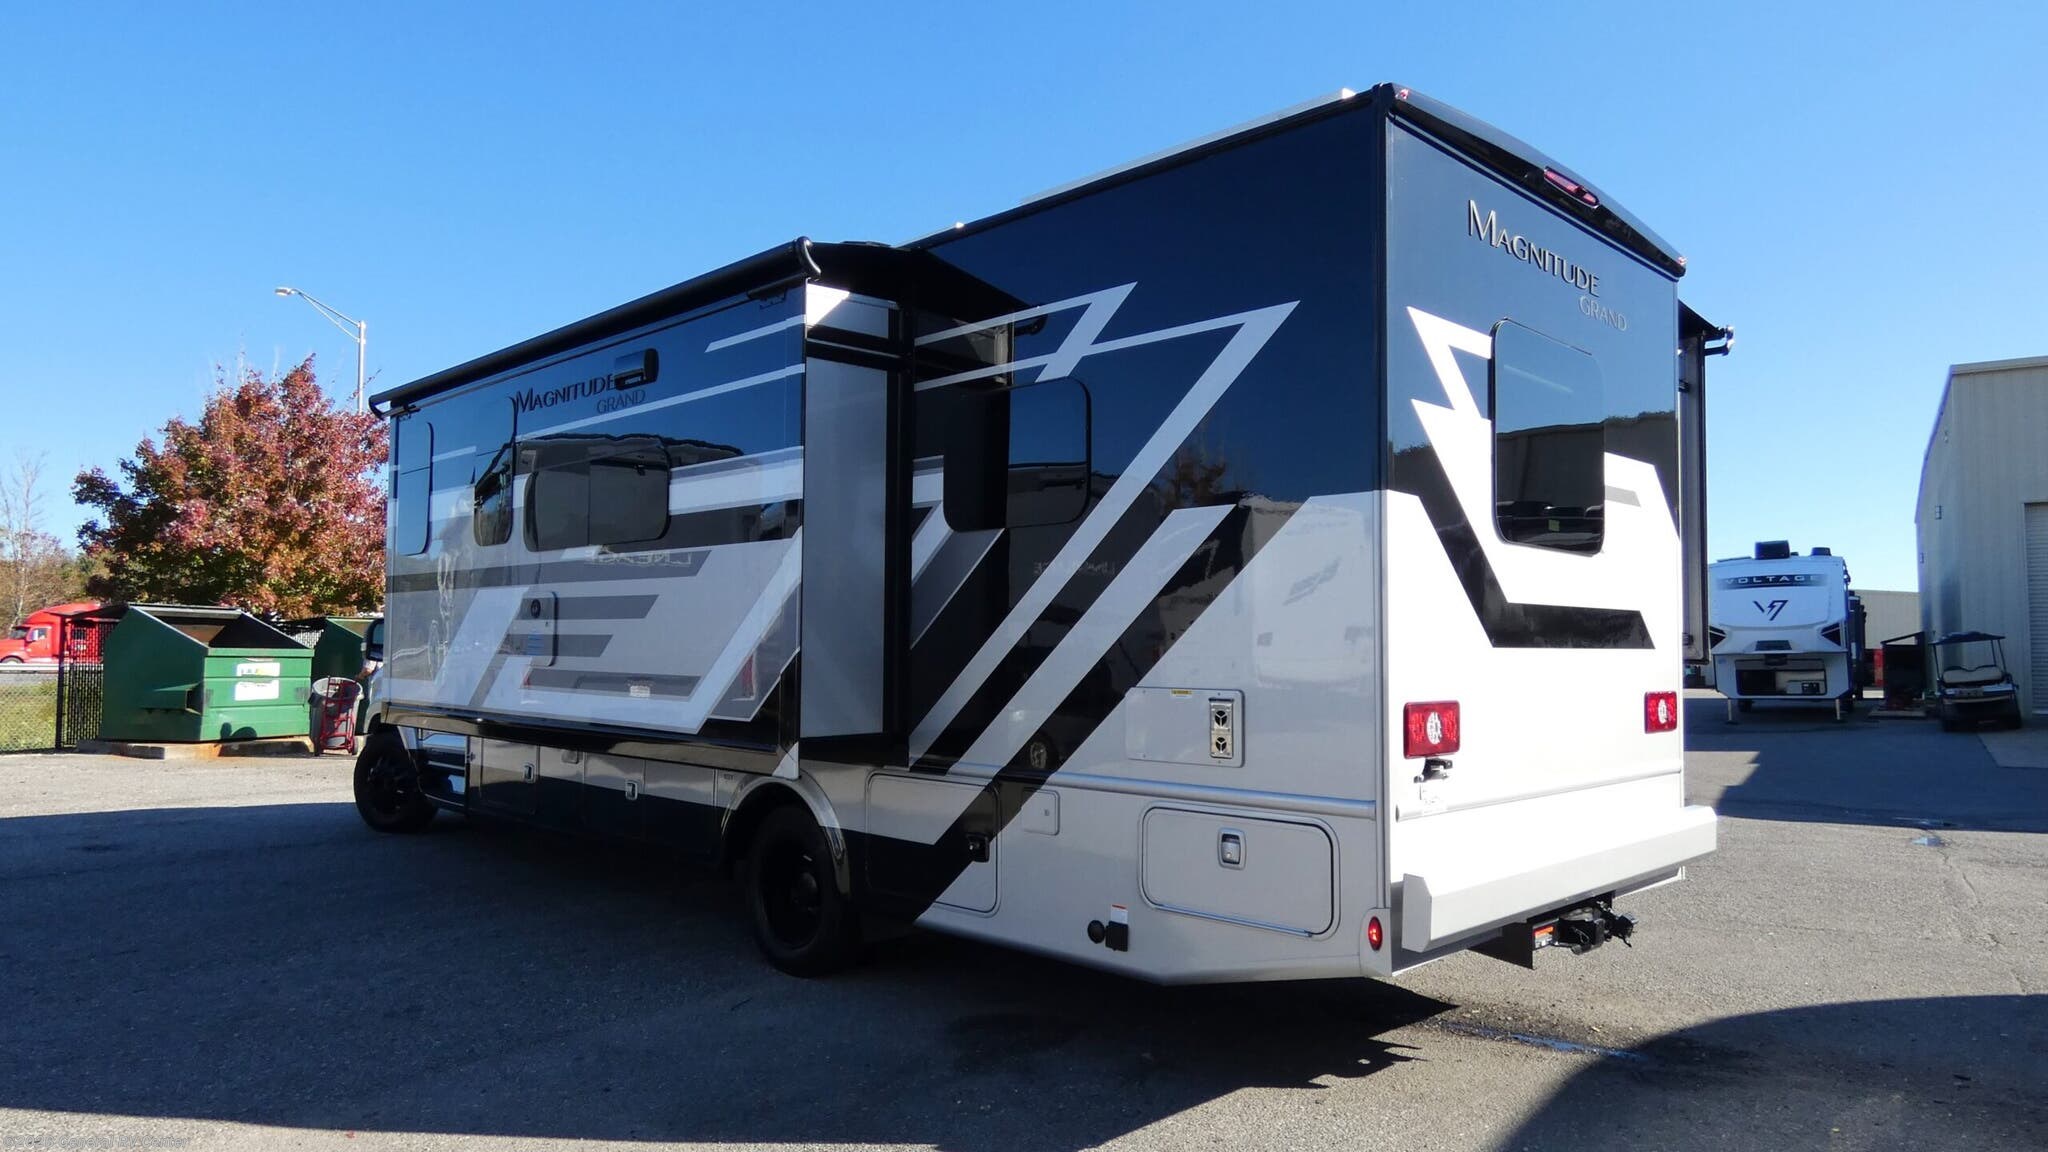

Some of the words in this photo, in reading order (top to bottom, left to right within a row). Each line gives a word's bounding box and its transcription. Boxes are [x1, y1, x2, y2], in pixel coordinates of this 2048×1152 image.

[1468, 199, 1600, 298] MAGNITUDE
[1579, 295, 1628, 331] GRAND
[597, 389, 646, 414] GRAND
